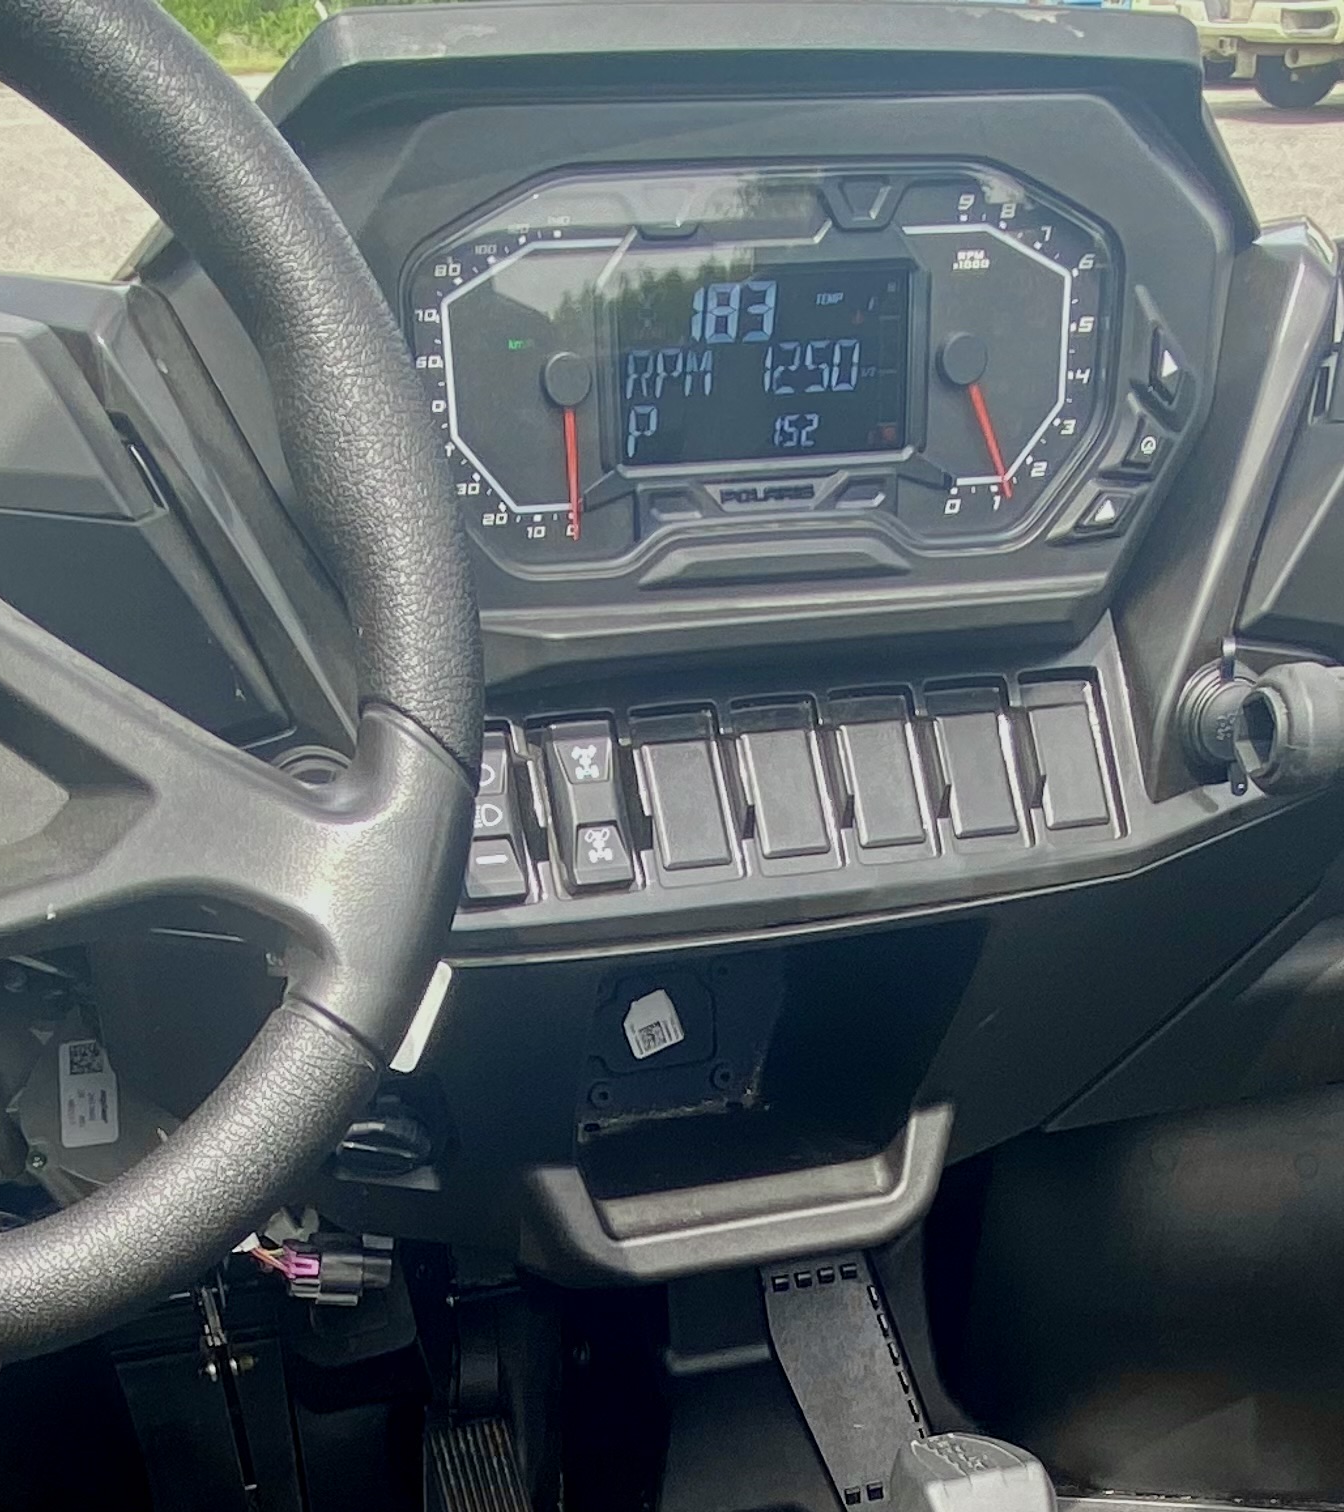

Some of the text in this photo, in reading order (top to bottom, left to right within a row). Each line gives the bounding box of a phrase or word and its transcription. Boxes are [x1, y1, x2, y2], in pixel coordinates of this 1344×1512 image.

[958, 193, 976, 210] 9
[1000, 203, 1017, 219] 8
[1041, 225, 1052, 242] 7
[474, 244, 497, 255] 100
[957, 250, 986, 260] RPM
[1078, 253, 1096, 270] 6
[434, 263, 462, 277] 80
[816, 292, 844, 306] TEMP
[414, 308, 438, 322] 70
[690, 280, 777, 344] 183
[1078, 316, 1095, 333] 5
[415, 355, 442, 369] 60
[625, 339, 861, 400] RPM 1250
[1075, 368, 1091, 384] 4
[627, 404, 658, 459] P
[1060, 418, 1077, 435] 3
[1030, 461, 1048, 477] 2
[456, 483, 481, 496] 30
[719, 483, 816, 505] POLARIS
[944, 498, 962, 515] 0
[993, 495, 1001, 512] 1
[482, 512, 508, 526] 20
[526, 525, 546, 539] 10
